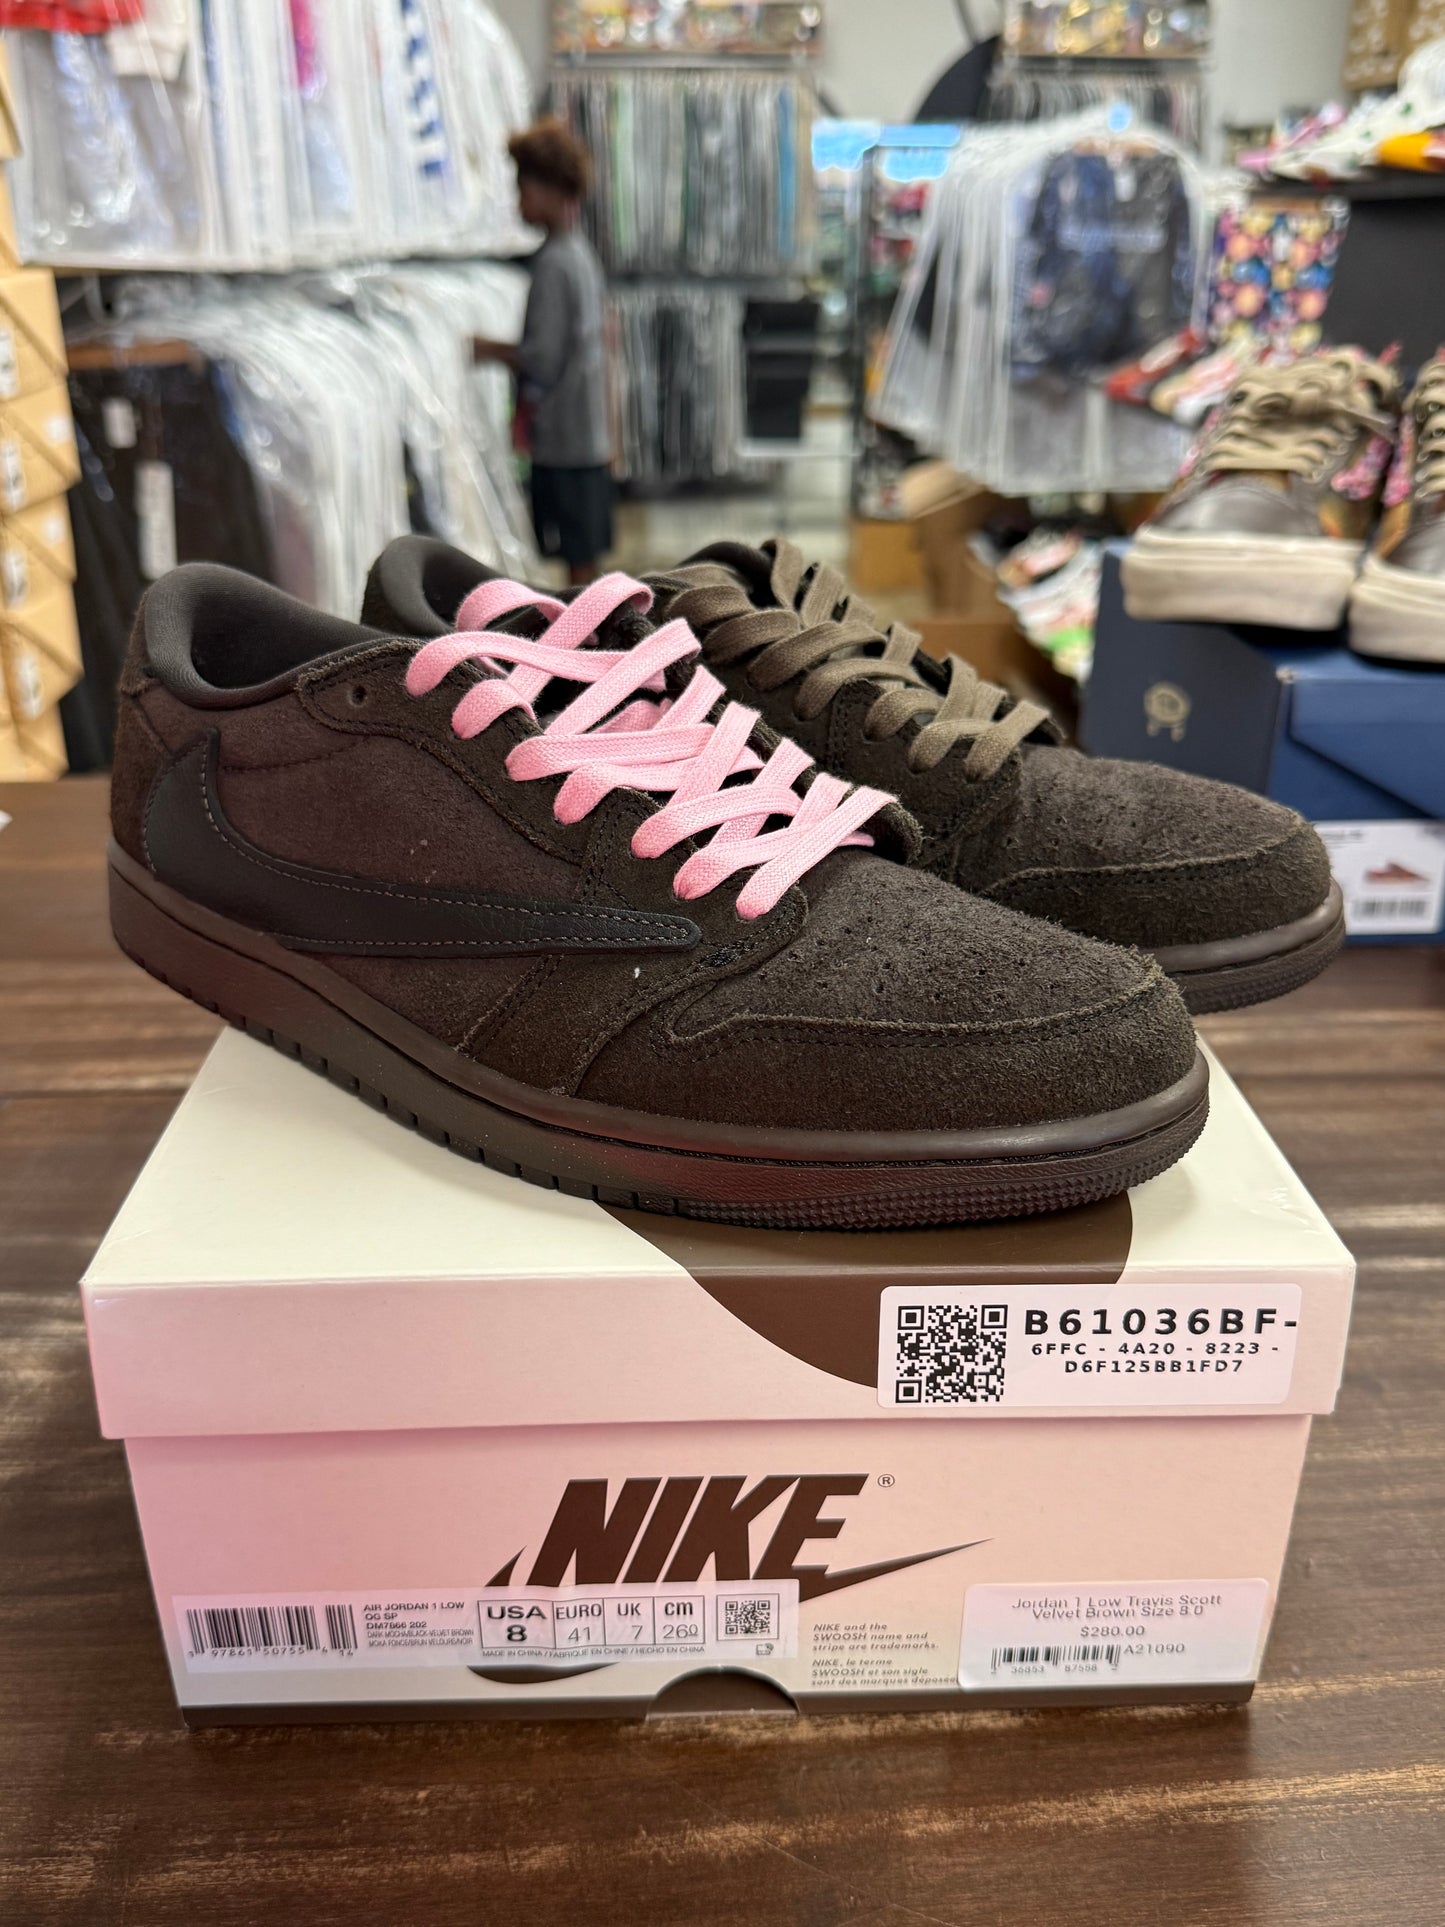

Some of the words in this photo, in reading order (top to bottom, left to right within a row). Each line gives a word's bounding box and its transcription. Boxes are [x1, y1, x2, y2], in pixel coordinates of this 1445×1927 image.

[1024, 1307, 1297, 1335] B61036BF-
[1032, 1343, 1087, 1356] 6FFC
[1118, 1343, 1175, 1356] 4A20
[1205, 1342, 1260, 1355] 8223
[1065, 1360, 1243, 1373] D6F125BB1FD7
[526, 1473, 869, 1586] NIKE
[385, 1603, 429, 1611] JORDAN
[1012, 1597, 1068, 1610] Jordan
[1088, 1597, 1121, 1608] Low
[1126, 1596, 1173, 1607] Travis
[1178, 1595, 1221, 1605] Scott
[487, 1605, 547, 1620] USA
[556, 1604, 602, 1620] EURO
[617, 1602, 641, 1617] UK
[664, 1601, 693, 1616] cm
[1032, 1608, 1080, 1619] Velvet
[1085, 1607, 1135, 1618] Brown
[1140, 1606, 1174, 1617] Size
[506, 1624, 528, 1642] 8
[568, 1626, 592, 1641] 41
[631, 1624, 643, 1640] 7
[663, 1624, 699, 1639] 260
[813, 1623, 840, 1632] NIKE
[844, 1623, 866, 1631] and
[1080, 1626, 1145, 1638] $280.00
[813, 1633, 867, 1641] SWOOSH
[604, 1647, 629, 1655] CHINE
[635, 1647, 664, 1655] HECHO
[812, 1643, 845, 1652] stripe
[1123, 1644, 1185, 1654] A21090
[812, 1668, 865, 1677] SWOOSH
[903, 1667, 928, 1676] sigle
[838, 1677, 857, 1685] des
[860, 1677, 908, 1686] marques
